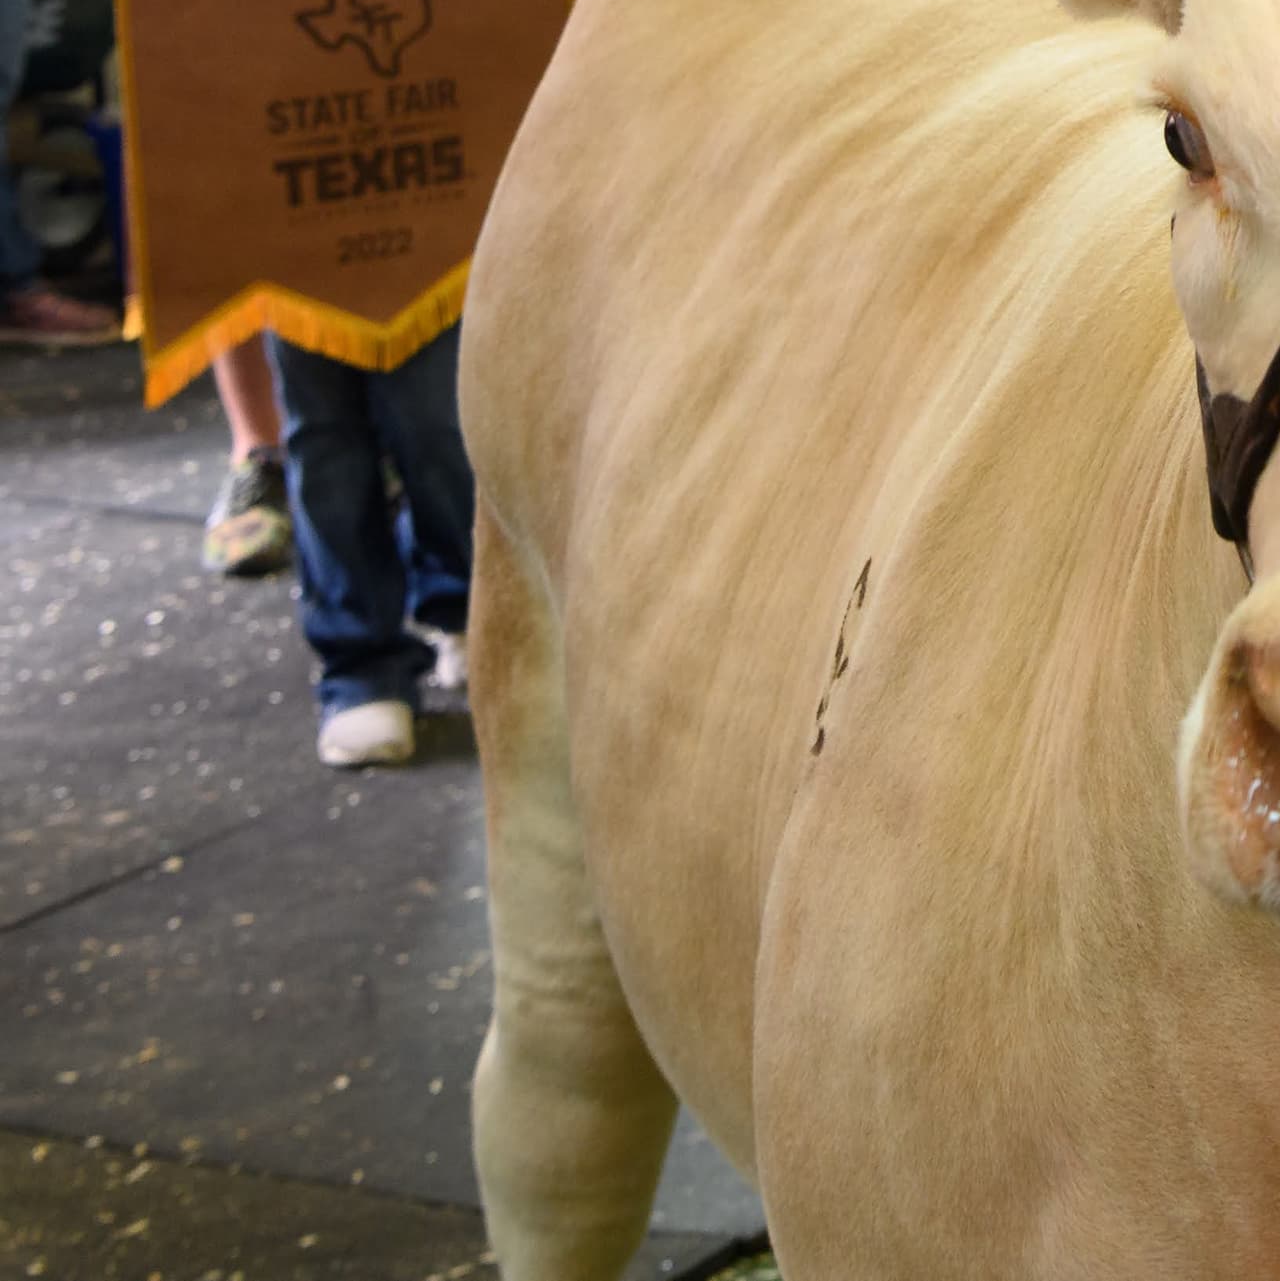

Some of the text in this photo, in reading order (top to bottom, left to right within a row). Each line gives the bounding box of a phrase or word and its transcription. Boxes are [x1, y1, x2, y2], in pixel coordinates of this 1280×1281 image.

[265, 76, 458, 136] STATE FAIR
[272, 134, 465, 208] TEXAS
[337, 226, 414, 265] 2022
